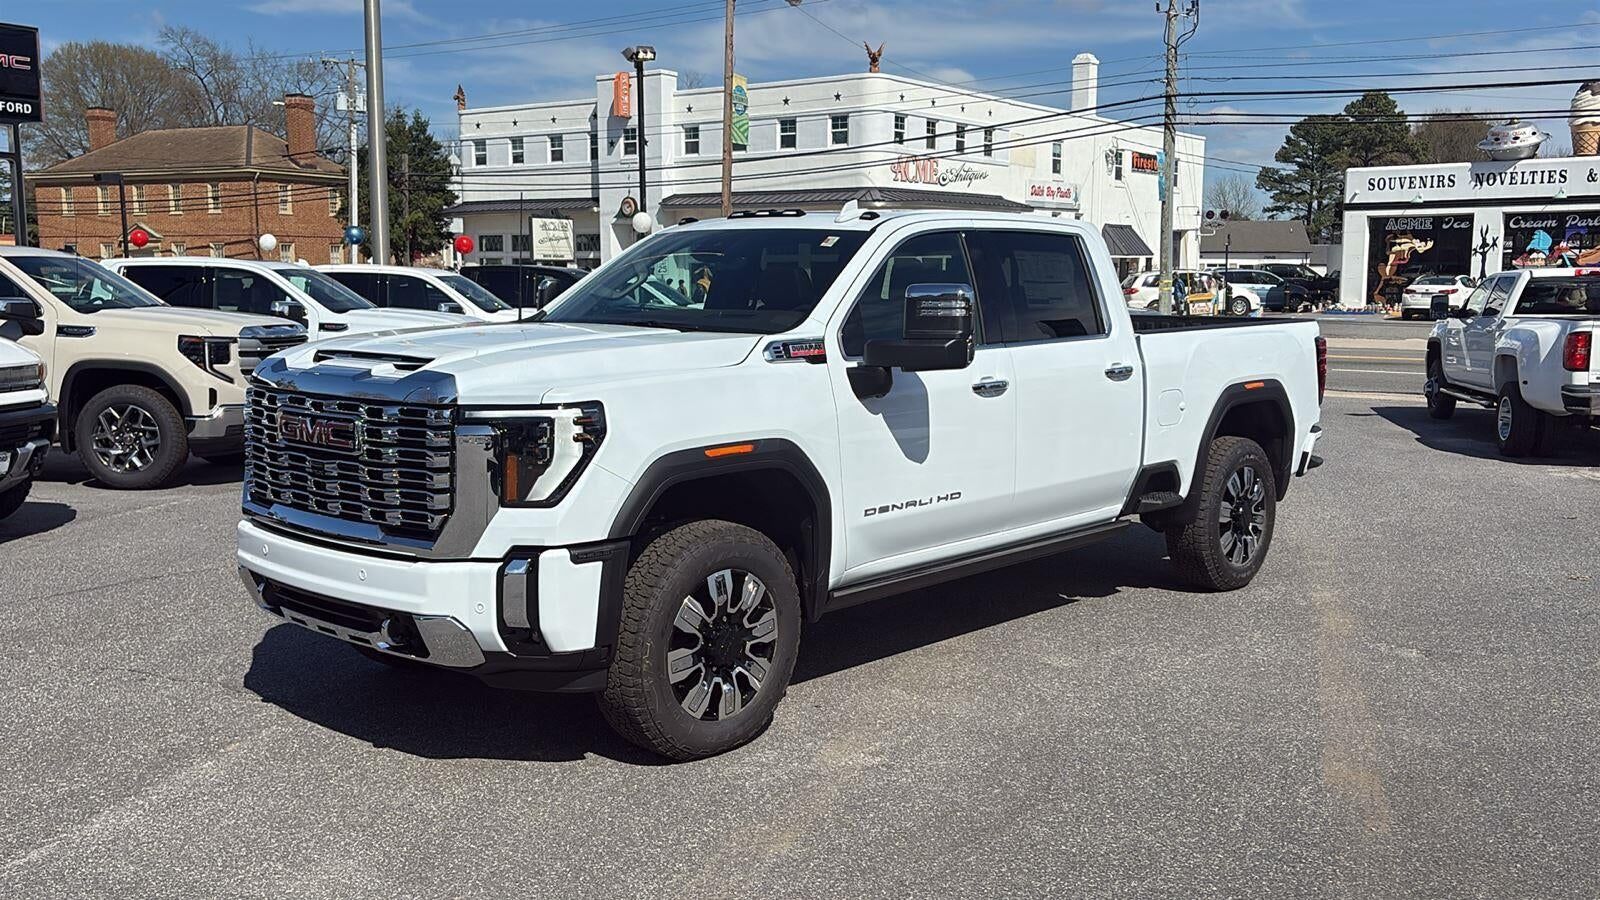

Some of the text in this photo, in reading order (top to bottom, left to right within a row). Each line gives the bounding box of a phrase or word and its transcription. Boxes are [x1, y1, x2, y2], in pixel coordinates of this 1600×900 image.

[0, 101, 32, 114] FORD
[891, 155, 989, 188] ACME Antiques
[1368, 168, 1598, 191] SOUVENIRS NOVELTIES &
[1386, 216, 1471, 231] ACME Ice
[1509, 216, 1559, 228] Cream
[791, 344, 823, 352] DURAMAX
[280, 414, 355, 449] GMC
[864, 491, 962, 517] DENALI HD
